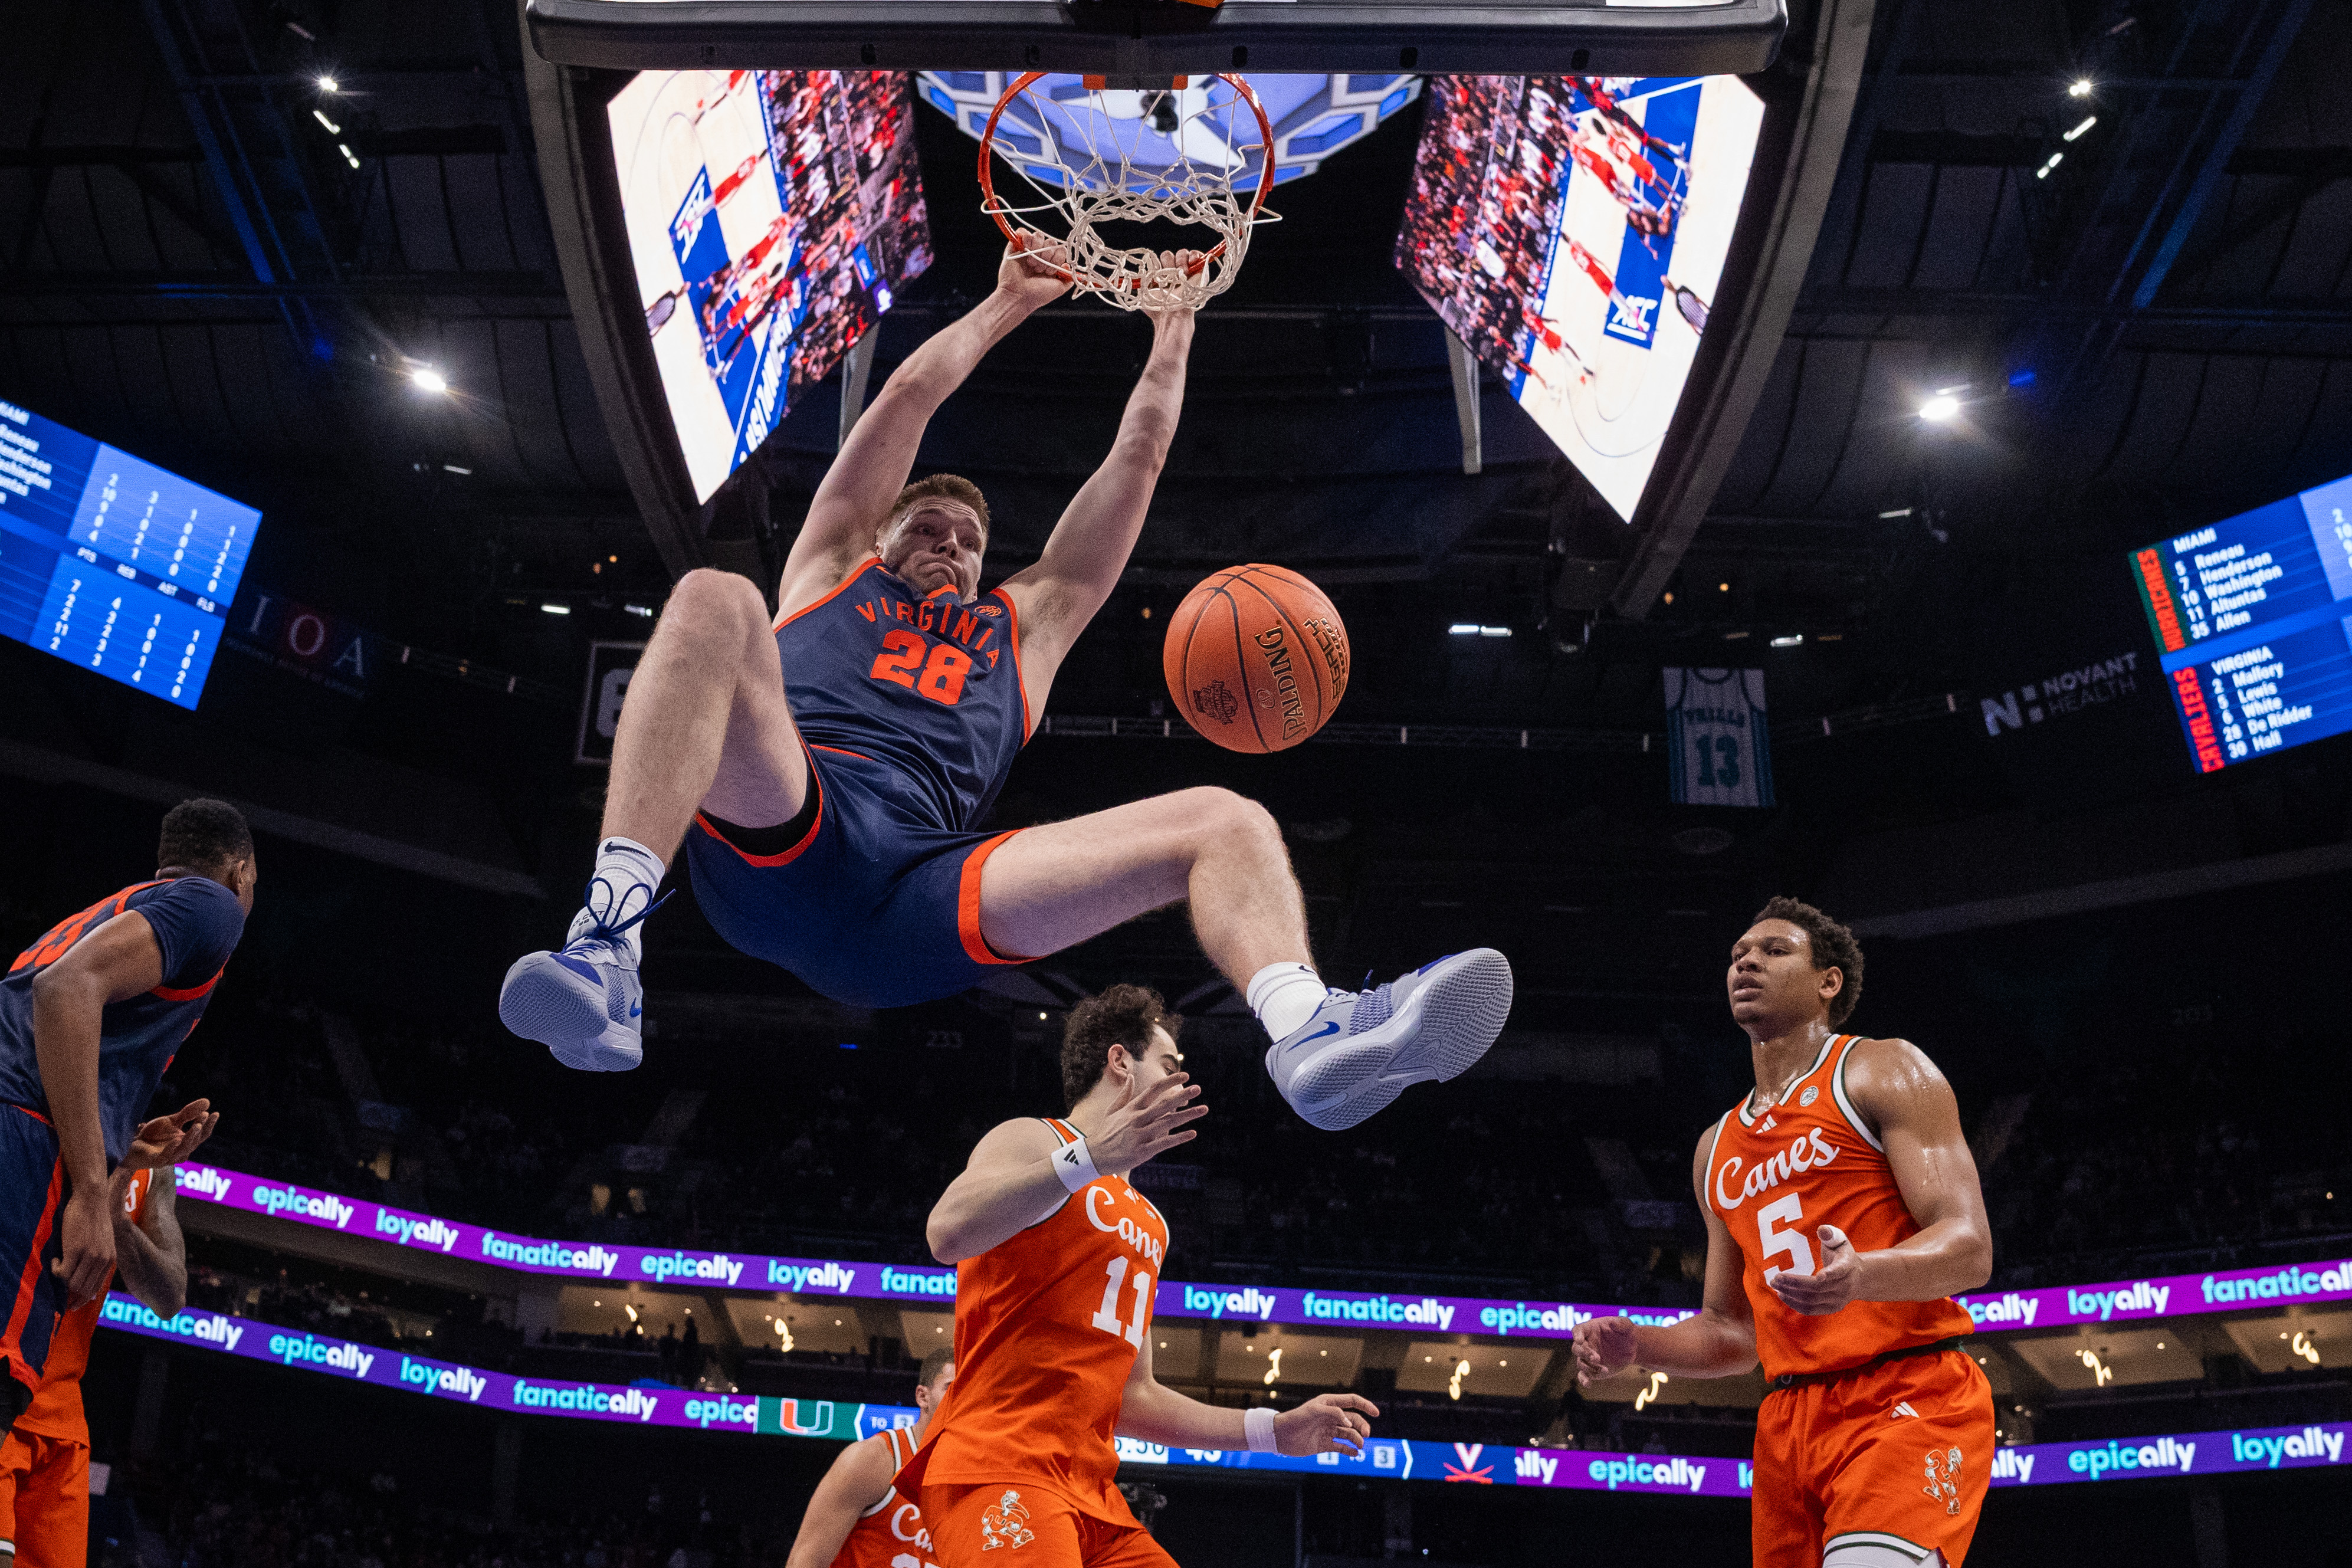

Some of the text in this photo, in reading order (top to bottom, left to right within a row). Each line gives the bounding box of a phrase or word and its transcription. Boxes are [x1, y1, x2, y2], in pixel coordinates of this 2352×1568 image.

[2173, 527, 2216, 553] MIAMI
[2179, 576, 2190, 592] 7
[2200, 552, 2272, 585] Henderson
[2181, 589, 2200, 608] 10
[2203, 565, 2283, 600] Washington
[855, 596, 999, 669] VIRGINIA
[2187, 605, 2204, 622] 11
[2216, 610, 2251, 632] Allen
[870, 629, 973, 705] 28
[2042, 652, 2137, 697] NOVANT
[2211, 645, 2274, 675] VIRGINIA
[2212, 661, 2284, 694] 2 Mallory
[2048, 676, 2137, 716] HEALTH
[2238, 681, 2277, 704] Lewis
[2242, 697, 2282, 719] White
[2173, 666, 2224, 773] CAVALIERS
[2223, 724, 2242, 742] 28
[2247, 719, 2267, 735] De
[1695, 734, 1740, 788] 13
[2228, 730, 2282, 759] 30 Hall
[1716, 1127, 1840, 1210] Canes
[253, 1186, 354, 1229] epically
[376, 1208, 459, 1251] loyally
[482, 1232, 618, 1276] fanatically
[641, 1251, 744, 1286] epically
[768, 1259, 855, 1293] loyally
[880, 1267, 957, 1295] fanat
[1085, 1186, 1162, 1270] Cane
[1757, 1192, 1816, 1290] 5
[1092, 1255, 1151, 1353] 11
[1185, 1285, 1275, 1320] loyally
[1303, 1292, 1455, 1330] fanatically
[2068, 1281, 2170, 1320] loyally
[269, 1334, 374, 1377] epically
[400, 1356, 486, 1401] loyally
[513, 1379, 658, 1421] fanatically
[1589, 1455, 1706, 1492] epically
[2068, 1436, 2196, 1480] epically
[2232, 1426, 2344, 1468] loyally
